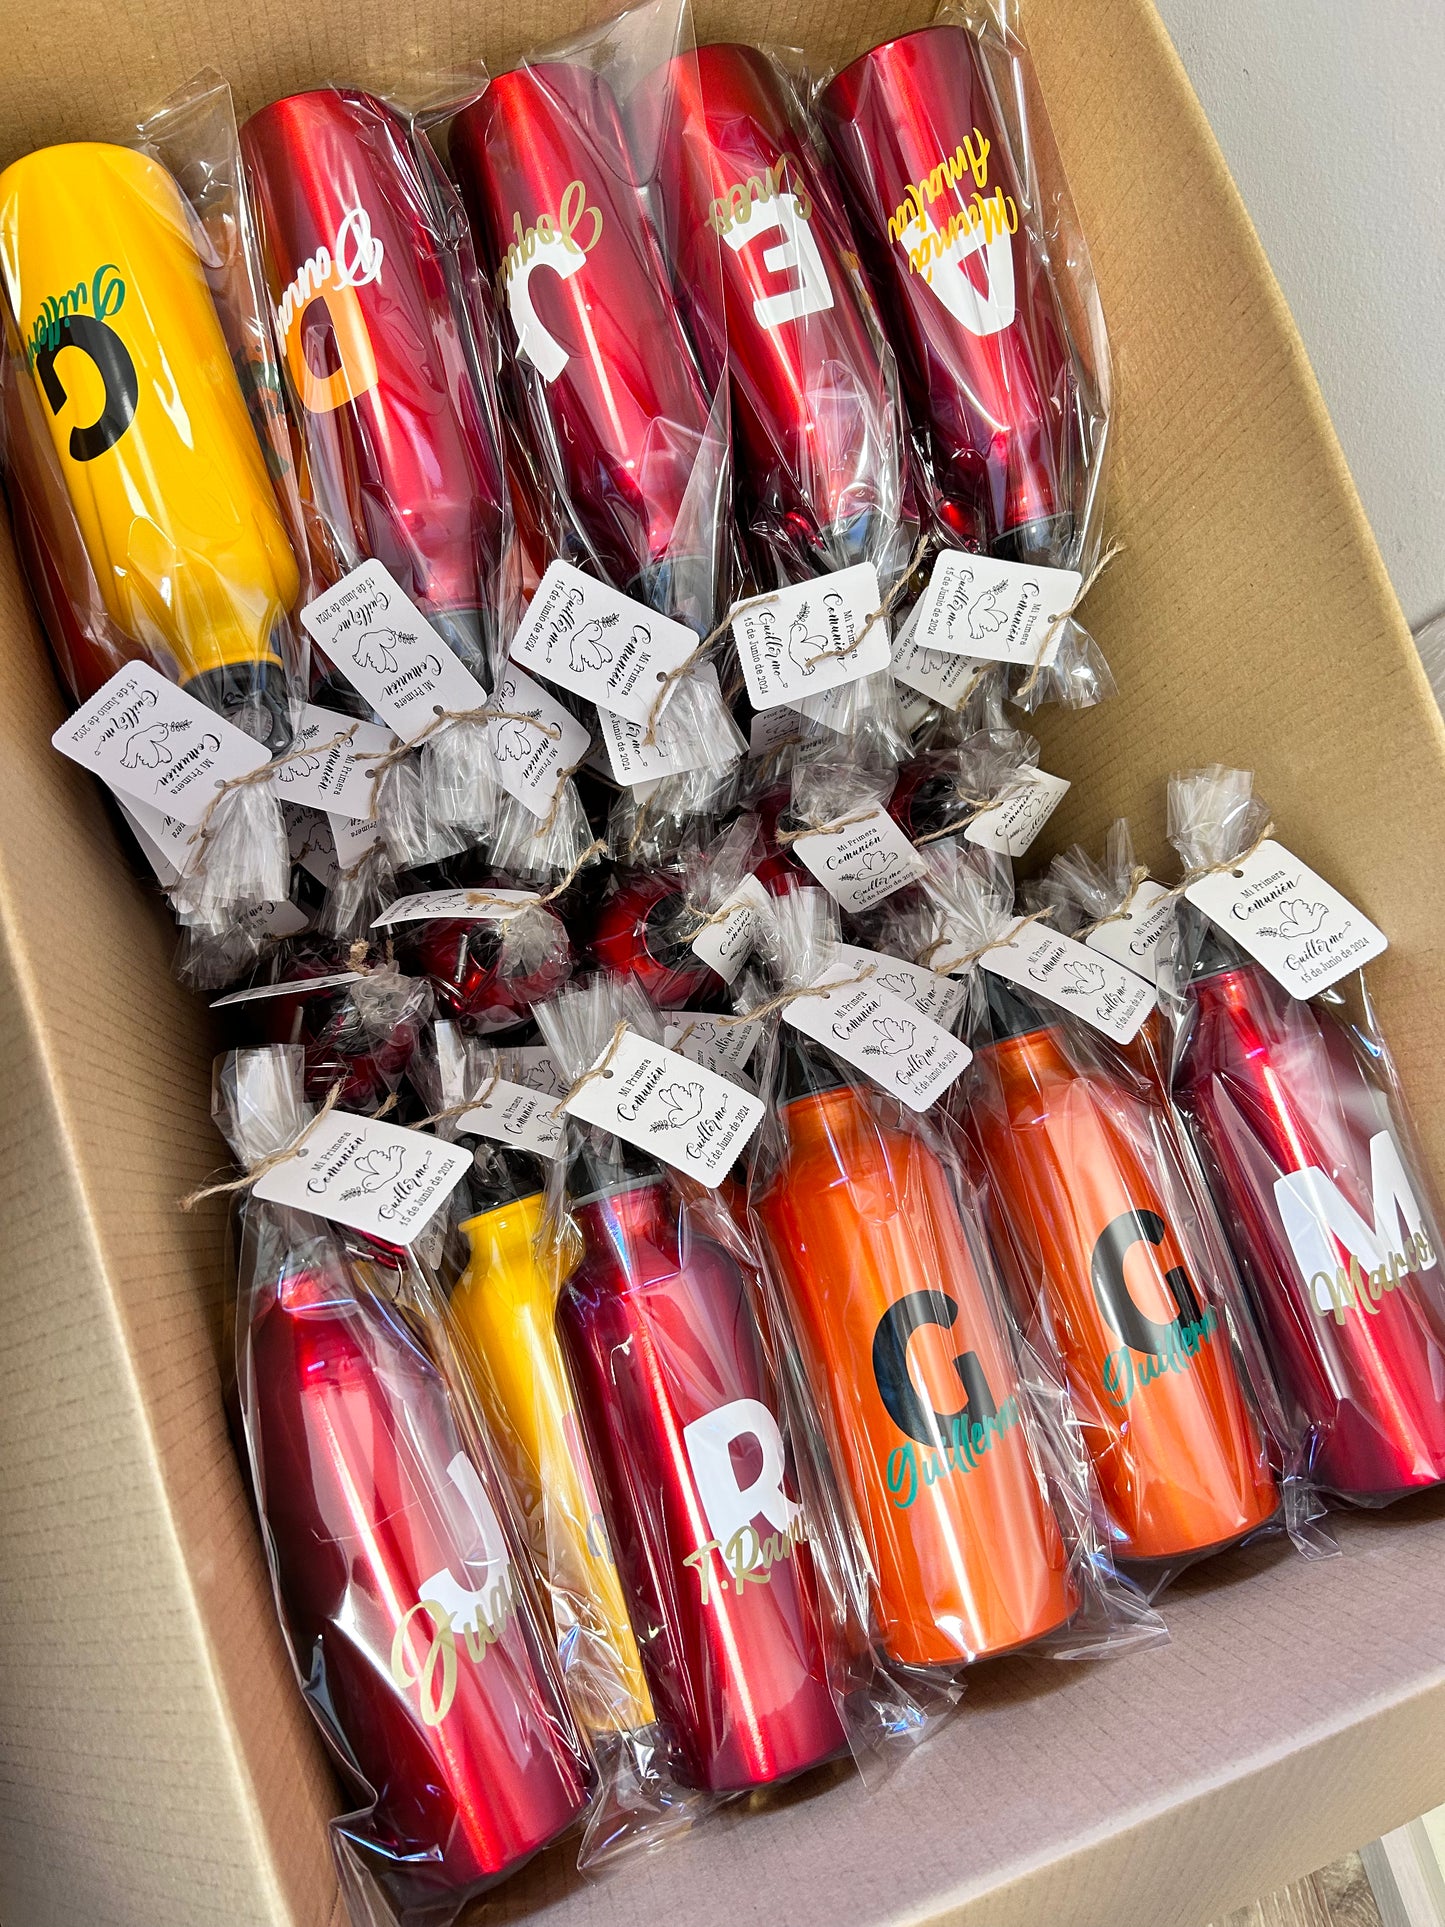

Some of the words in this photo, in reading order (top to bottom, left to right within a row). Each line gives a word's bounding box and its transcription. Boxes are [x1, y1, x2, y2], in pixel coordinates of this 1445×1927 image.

[888, 127, 990, 244] Amalia
[910, 186, 1018, 284] Mamá
[723, 193, 834, 330] E
[900, 197, 1016, 336] A
[507, 230, 586, 384] J
[286, 260, 378, 413] D
[941, 575, 953, 587] de
[945, 566, 956, 577] 15
[355, 582, 367, 594] de
[364, 576, 376, 591] 15
[554, 578, 566, 593] 15
[338, 589, 359, 607] Junio
[548, 588, 561, 601] de
[935, 586, 950, 607] Junio
[945, 565, 975, 637] Guillermo
[314, 608, 333, 625] 2024
[329, 602, 341, 613] de
[334, 585, 392, 642] Guillermo
[538, 599, 556, 622] Junio
[842, 609, 853, 623] Mi
[931, 607, 943, 618] de
[1005, 577, 1041, 653] Comunión
[1030, 603, 1043, 614] Mi
[532, 621, 545, 634] de
[546, 585, 585, 661] Guillermo
[743, 616, 756, 627] 15
[926, 617, 939, 636] 2024
[1019, 614, 1039, 646] Primera
[524, 631, 540, 652] 2024
[746, 628, 757, 639] de
[845, 623, 859, 660] Primra
[904, 638, 910, 647] de
[748, 640, 762, 663] Junio
[751, 607, 788, 684] Guillermo
[894, 648, 905, 663] 2024
[605, 622, 652, 699] Comunión
[637, 650, 652, 664] Mi
[379, 653, 445, 702] Comunión
[620, 662, 645, 696] Primera
[754, 663, 765, 675] de
[116, 687, 131, 699] de
[126, 678, 140, 692] 15
[420, 679, 436, 693] Mi
[756, 675, 769, 694] 2024
[97, 696, 122, 717] Junio
[393, 686, 425, 709] Primera
[87, 714, 102, 727] de
[96, 686, 160, 754] Guillermo
[612, 720, 623, 740] Junio
[70, 723, 92, 743] 2024
[520, 722, 563, 788] Cmunión
[617, 742, 625, 752] de
[154, 732, 223, 795] Comunión
[198, 757, 215, 770] Mi
[345, 754, 355, 764] Mi
[620, 753, 631, 771] 2024
[170, 767, 204, 795] Primera
[334, 764, 352, 795] Primera
[531, 756, 552, 788] Primera
[822, 830, 890, 871] Comunión
[849, 864, 907, 903] Guillermo
[1239, 887, 1256, 899] Mi
[1251, 869, 1287, 892] Primera
[1229, 873, 1302, 921] Comunión
[1142, 906, 1169, 929] Primera
[1032, 938, 1054, 958] Primera
[1282, 922, 1349, 976] Guillermo
[1027, 954, 1040, 964] Mi
[1028, 941, 1068, 983] Comunión
[1299, 971, 1313, 984] 15
[1309, 967, 1323, 978] de
[1319, 954, 1343, 972] Junio
[1339, 948, 1353, 959] de
[1349, 936, 1370, 953] 2024
[833, 1008, 848, 1020] Mi
[841, 990, 869, 1013] Primera
[1095, 978, 1128, 1024] Guillermo
[1130, 998, 1142, 1007] de
[1134, 987, 1148, 1002] 2024
[831, 993, 882, 1041] Comunión
[1118, 1016, 1130, 1025] de
[1122, 1004, 1138, 1019] Junio
[1115, 1019, 1126, 1031] 15
[894, 1037, 938, 1089] Guillermo
[937, 1060, 949, 1071] de
[943, 1048, 959, 1064] 2024
[617, 1085, 633, 1098] Mi
[625, 1058, 653, 1087] Primera
[918, 1080, 931, 1090] de
[924, 1067, 943, 1084] Junio
[616, 1057, 667, 1123] Comunión
[912, 1084, 924, 1096] 15
[505, 1095, 524, 1114] Primera
[734, 1104, 751, 1123] 2024
[501, 1111, 510, 1120] Mi
[503, 1096, 540, 1135] Comunión
[728, 1120, 741, 1132] de
[685, 1095, 728, 1162] Guillermo
[716, 1130, 735, 1151] Junio
[309, 1160, 326, 1172] Mi
[319, 1131, 352, 1161] Primera
[710, 1148, 723, 1160] de
[305, 1127, 368, 1198] Comunión
[705, 1156, 717, 1169] 15
[377, 1153, 431, 1223] Guillermo
[398, 1214, 412, 1227] 15
[405, 1205, 420, 1217] de
[413, 1185, 436, 1207] Junio
[429, 1175, 444, 1186] de
[437, 1157, 456, 1176] 2024
[1273, 1129, 1437, 1311] M
[1091, 1209, 1204, 1355] G
[872, 1289, 997, 1449] G
[683, 1398, 803, 1579] R
[418, 1450, 514, 1634] J
